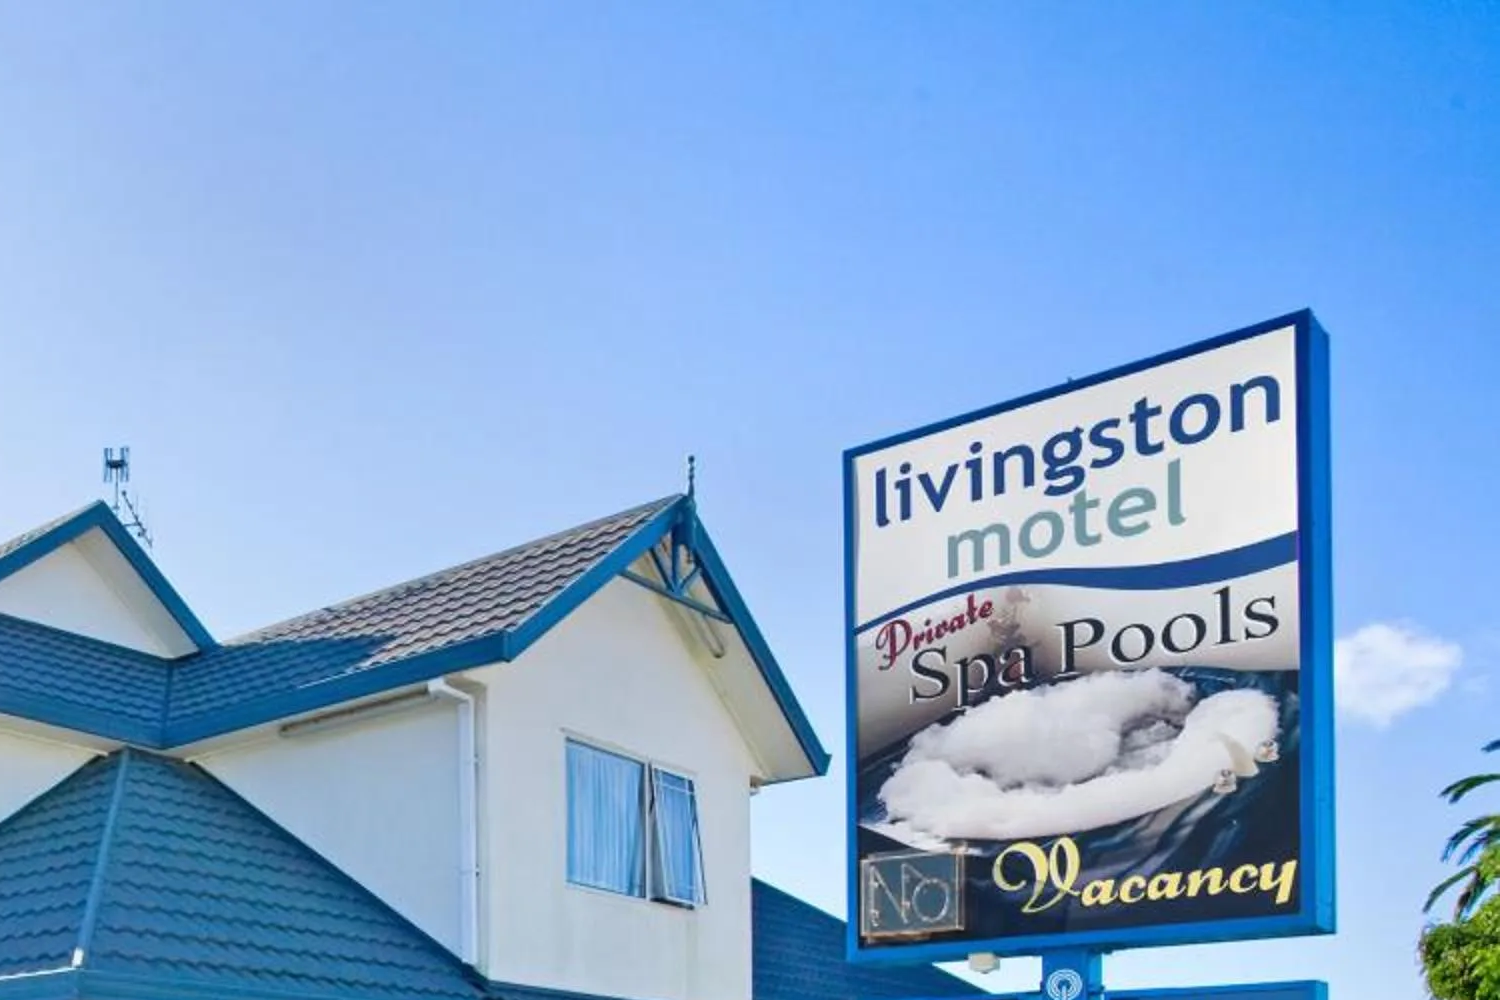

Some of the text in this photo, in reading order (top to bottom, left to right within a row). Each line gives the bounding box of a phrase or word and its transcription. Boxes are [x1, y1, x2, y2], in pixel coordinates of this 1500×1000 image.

[875, 374, 1281, 527] livingston
[947, 457, 1186, 578] motel
[875, 594, 994, 670] Private
[910, 586, 1280, 710] Spa Pools
[993, 837, 1297, 913] Vacancy
